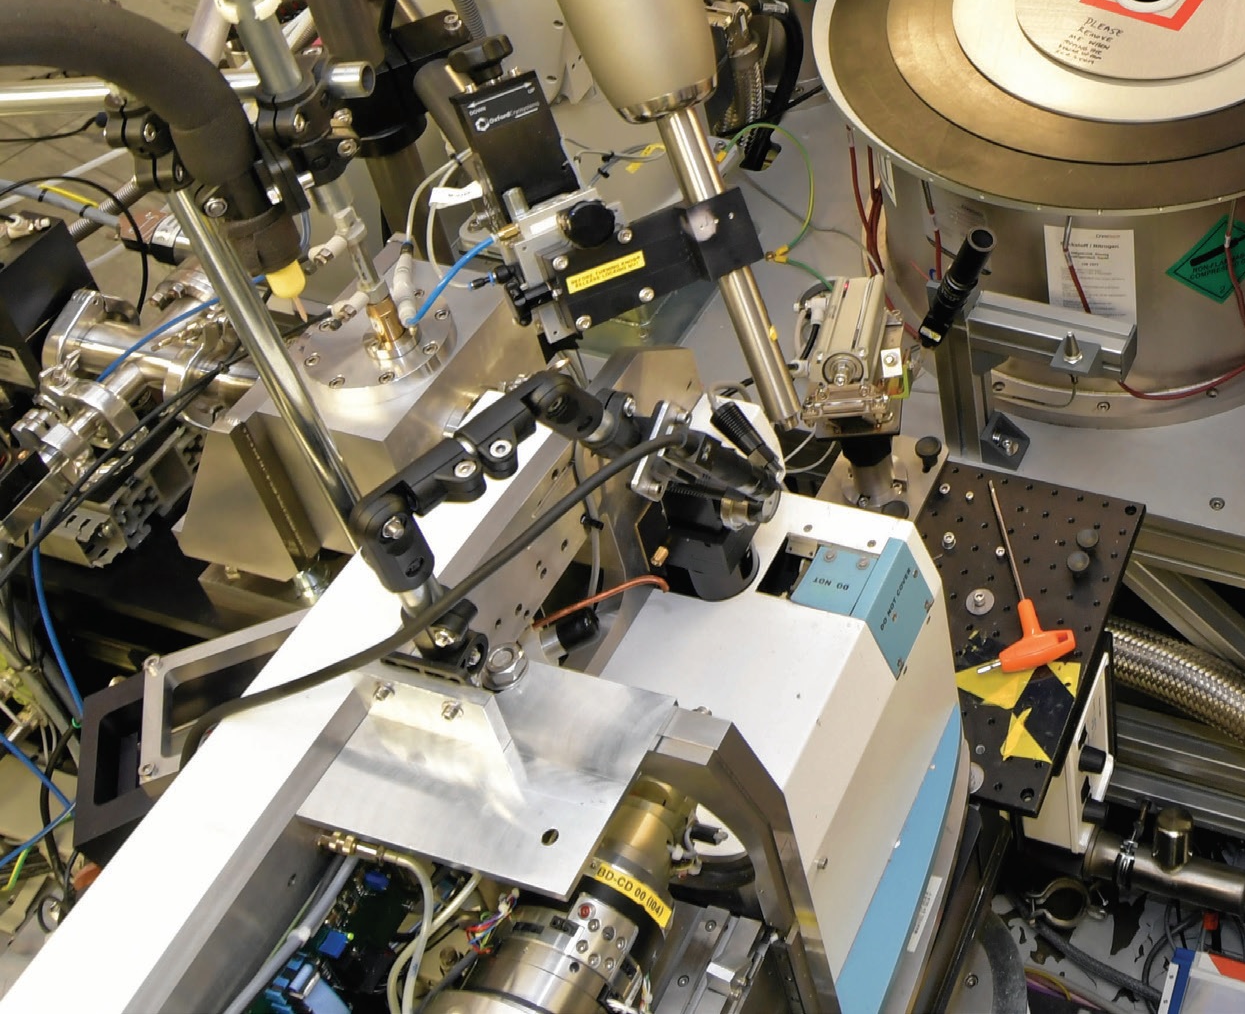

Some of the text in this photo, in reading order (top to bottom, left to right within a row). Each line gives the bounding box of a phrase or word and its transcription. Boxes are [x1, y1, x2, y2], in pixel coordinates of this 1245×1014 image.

[1077, 26, 1113, 42] REMOVE
[1084, 17, 1123, 37] PLEASE
[812, 576, 849, 591] DO NOT
[881, 568, 911, 631] DO NOT COVER
[597, 867, 633, 892] BD-CD
[634, 887, 646, 901] 00
